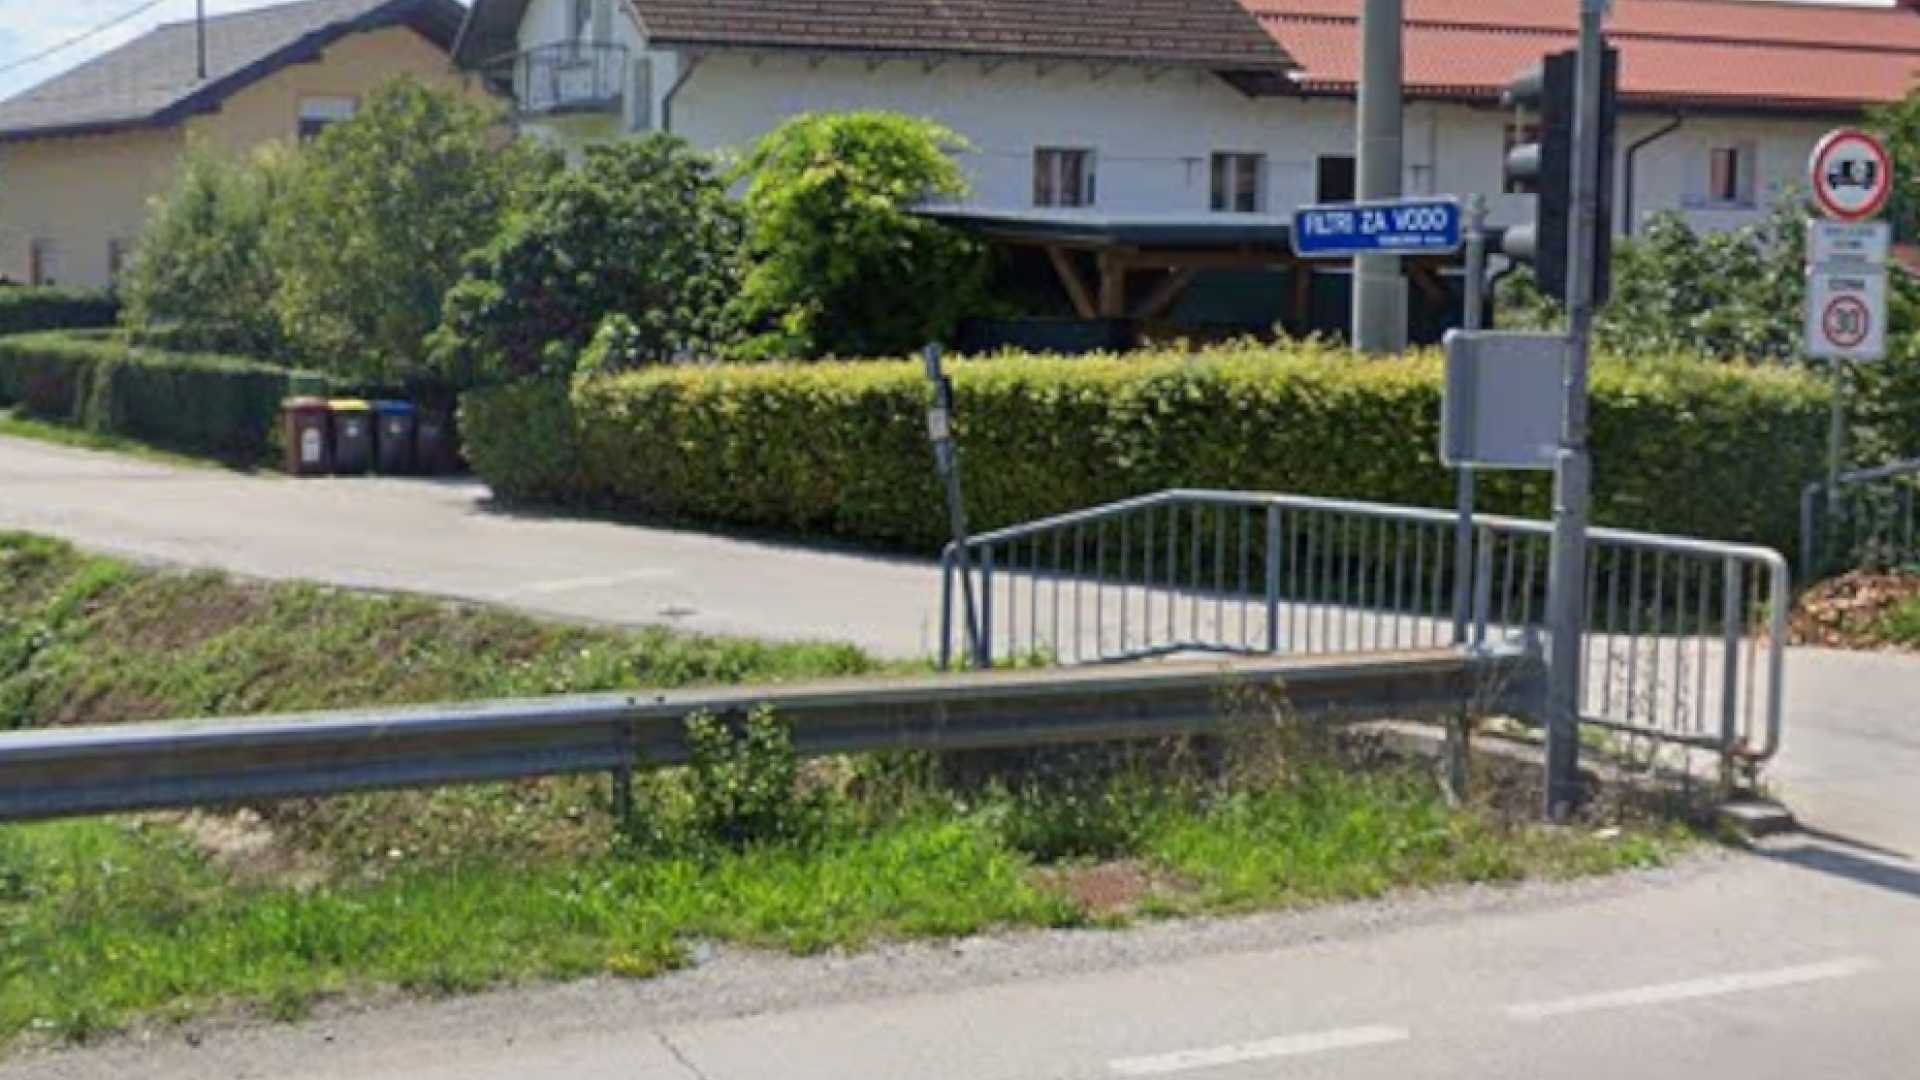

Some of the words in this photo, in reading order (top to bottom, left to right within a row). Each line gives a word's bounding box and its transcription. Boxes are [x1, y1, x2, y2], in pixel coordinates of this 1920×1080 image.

[1361, 208, 1388, 234] ZA
[1392, 204, 1448, 231] VODO
[1836, 308, 1859, 334] 30
